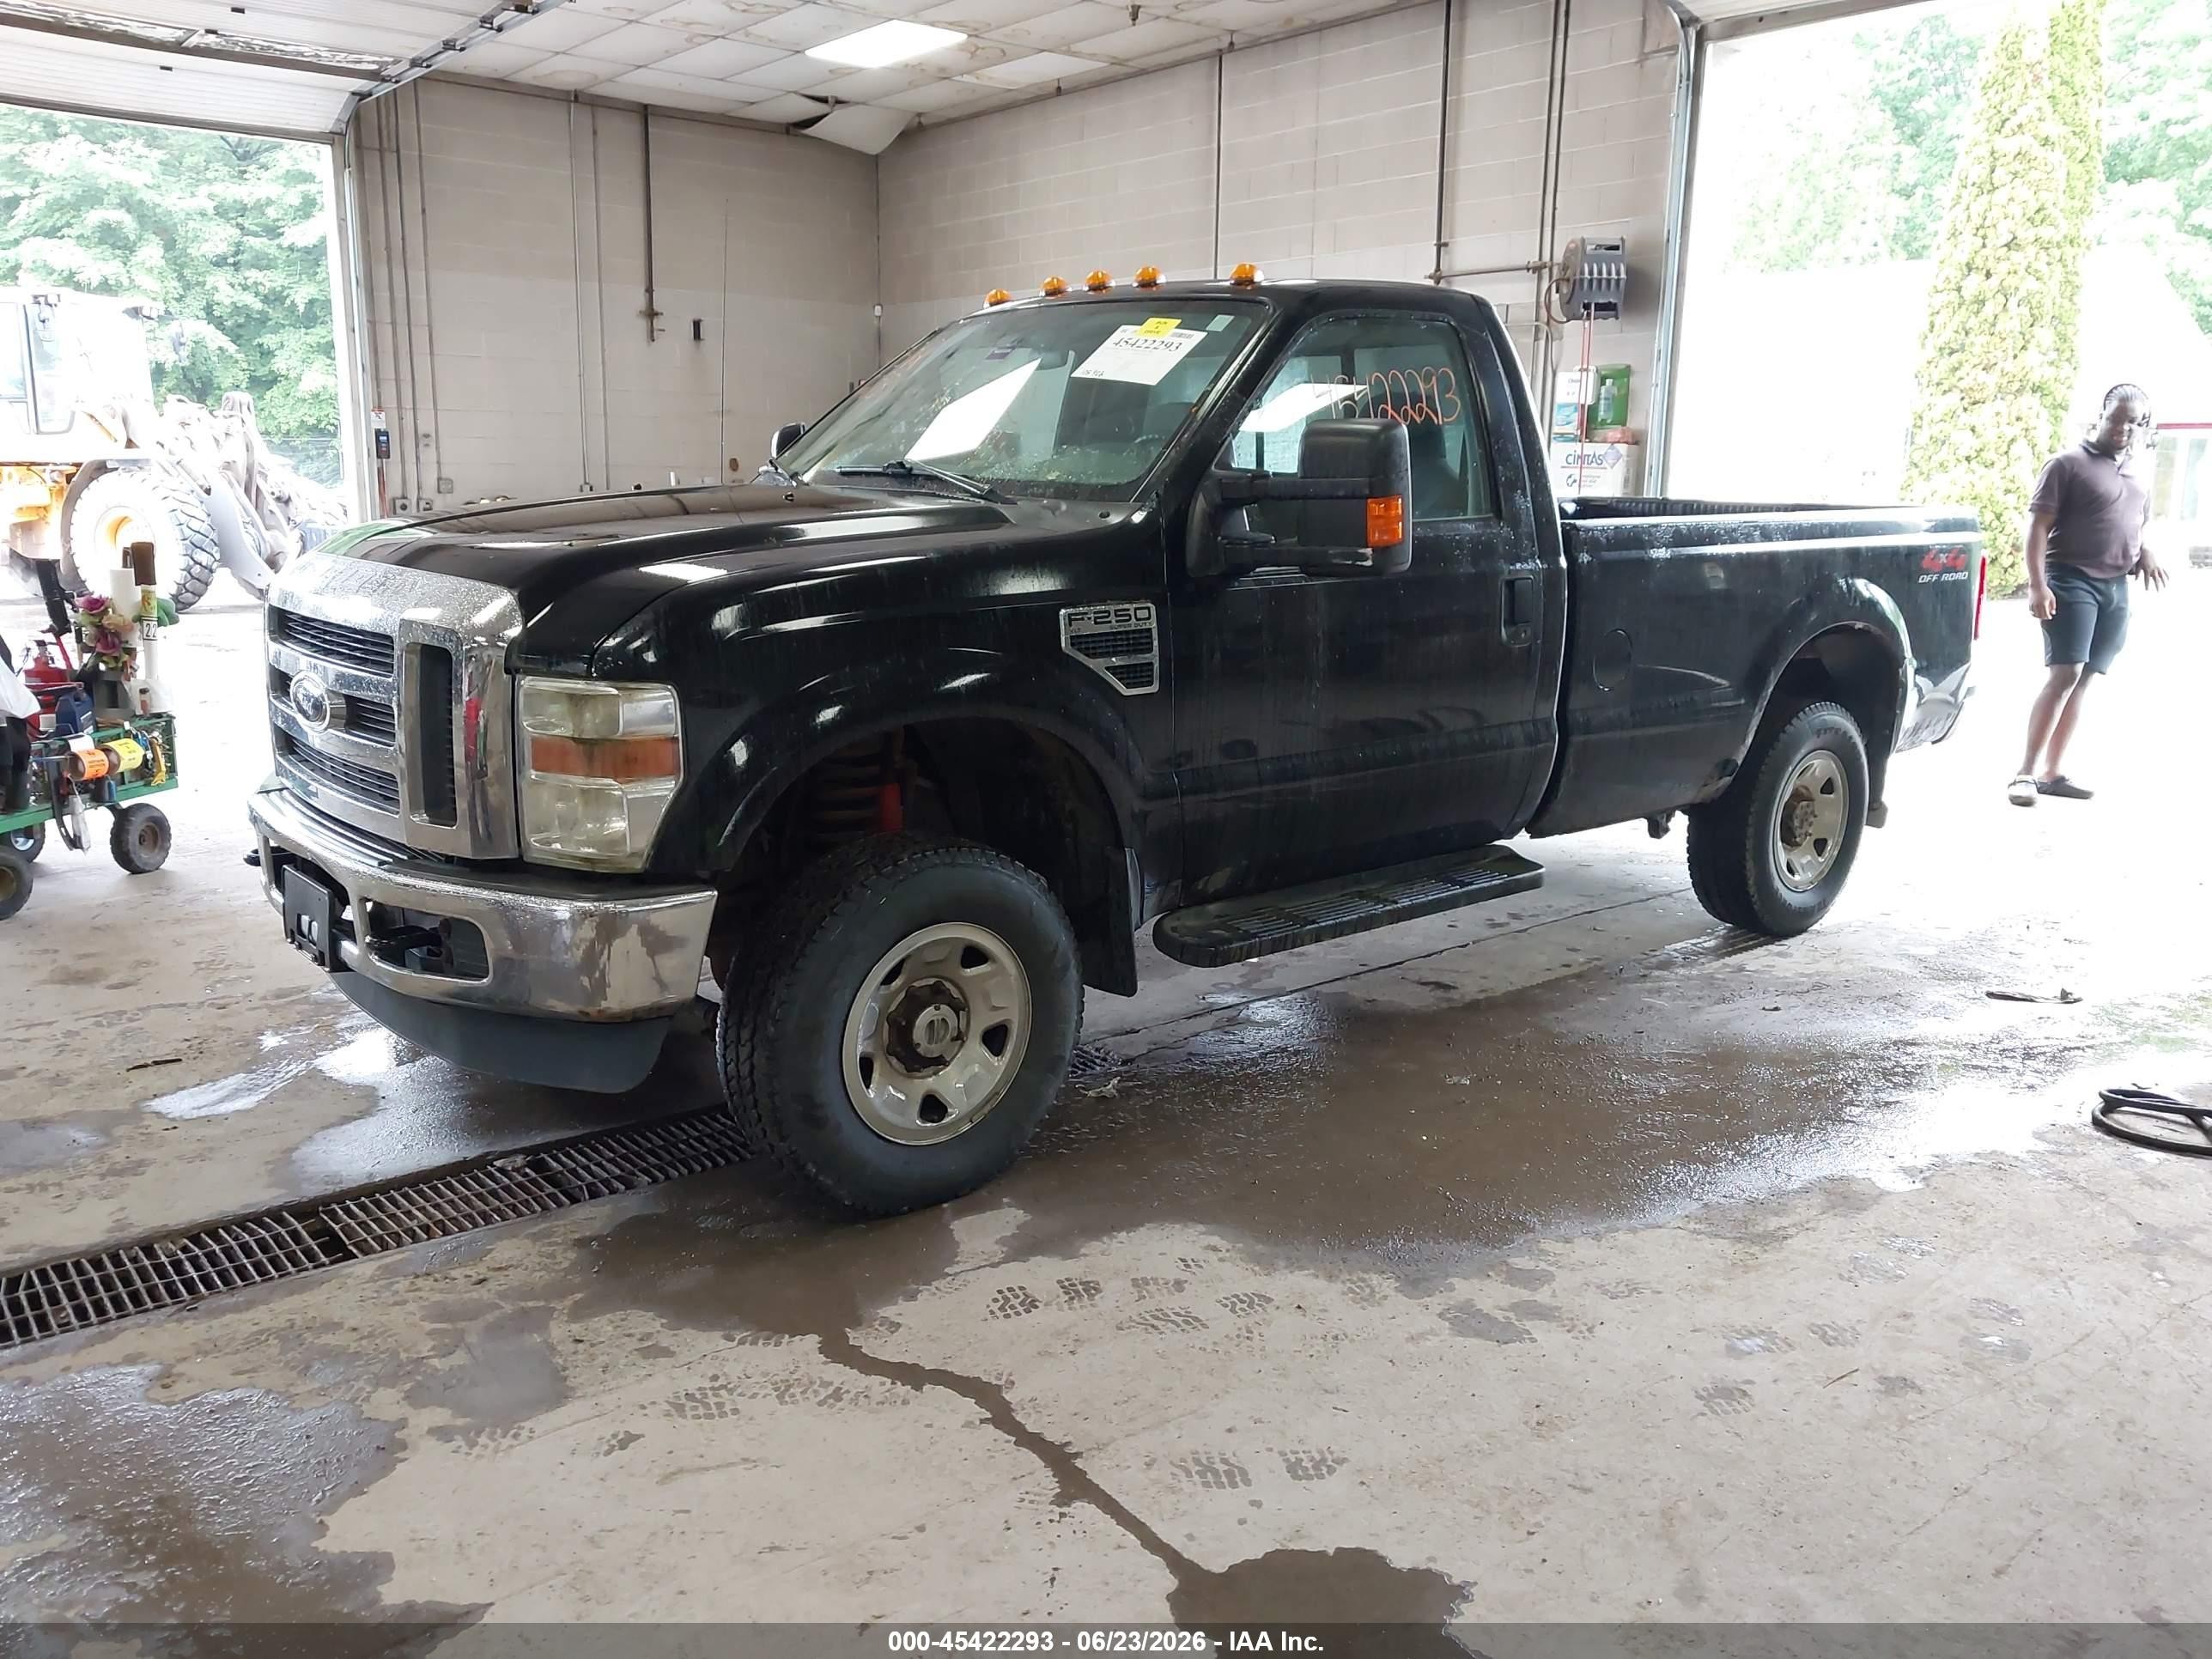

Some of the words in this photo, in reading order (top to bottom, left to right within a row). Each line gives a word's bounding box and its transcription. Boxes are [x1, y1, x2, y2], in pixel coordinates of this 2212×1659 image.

[1113, 337, 1182, 352] 45422293
[1918, 574, 1940, 583] OFF
[1941, 571, 1969, 581] ROAD
